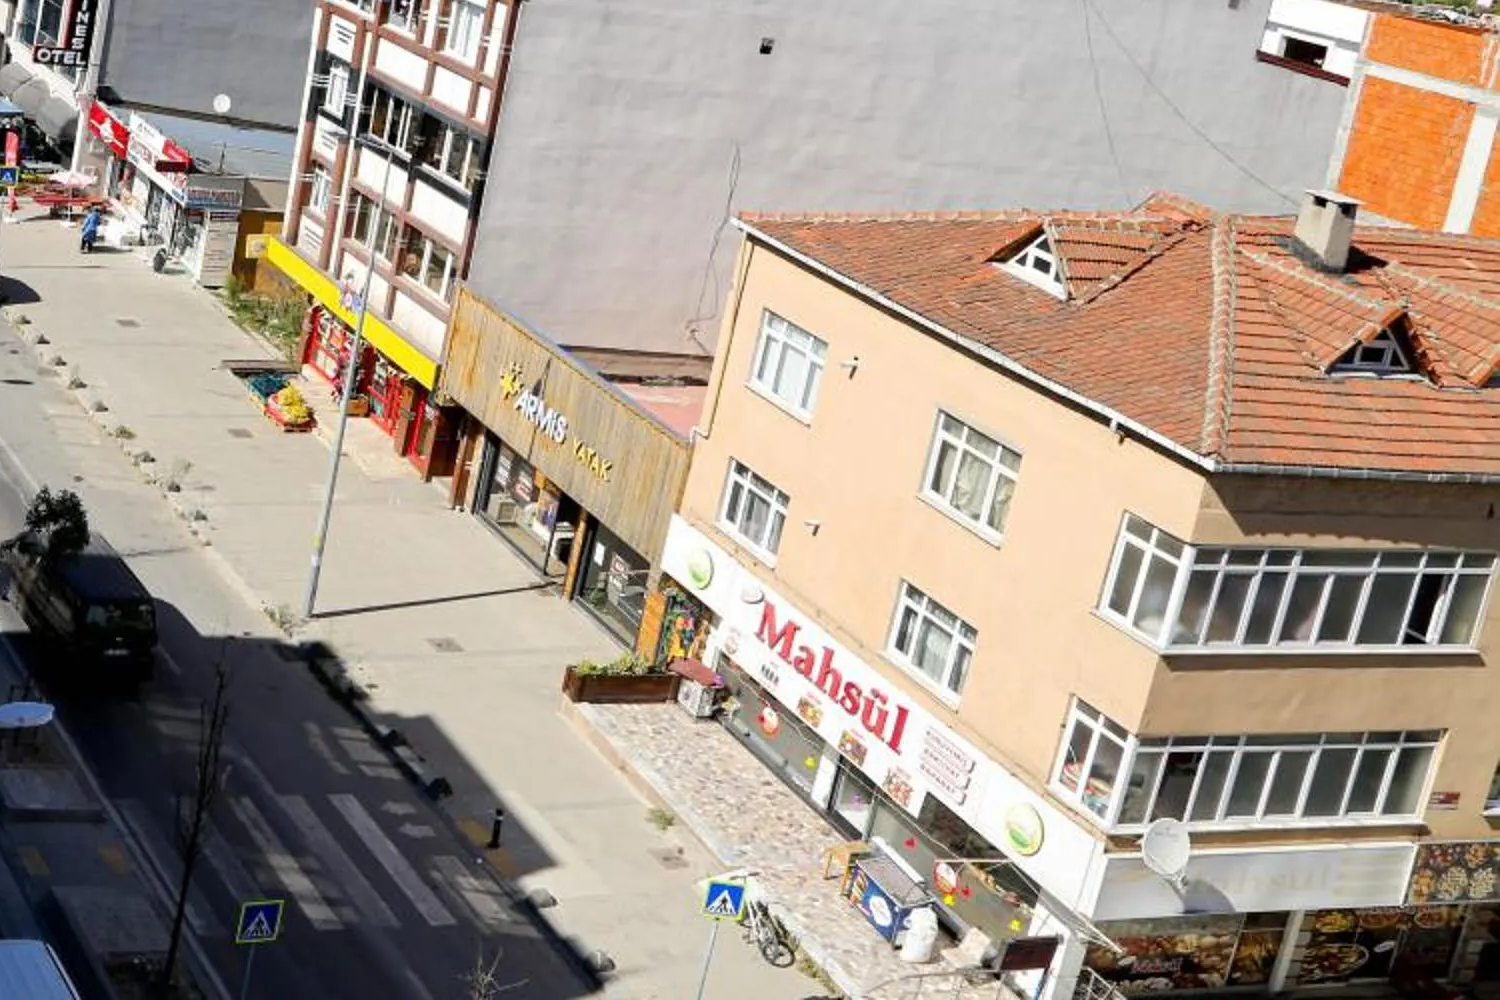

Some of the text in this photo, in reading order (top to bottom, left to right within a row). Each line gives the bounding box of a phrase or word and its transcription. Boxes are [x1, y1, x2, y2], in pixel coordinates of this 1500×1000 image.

[36, 48, 87, 66] OTEL
[573, 437, 612, 480] YATAK
[756, 600, 910, 755] Mahsül
